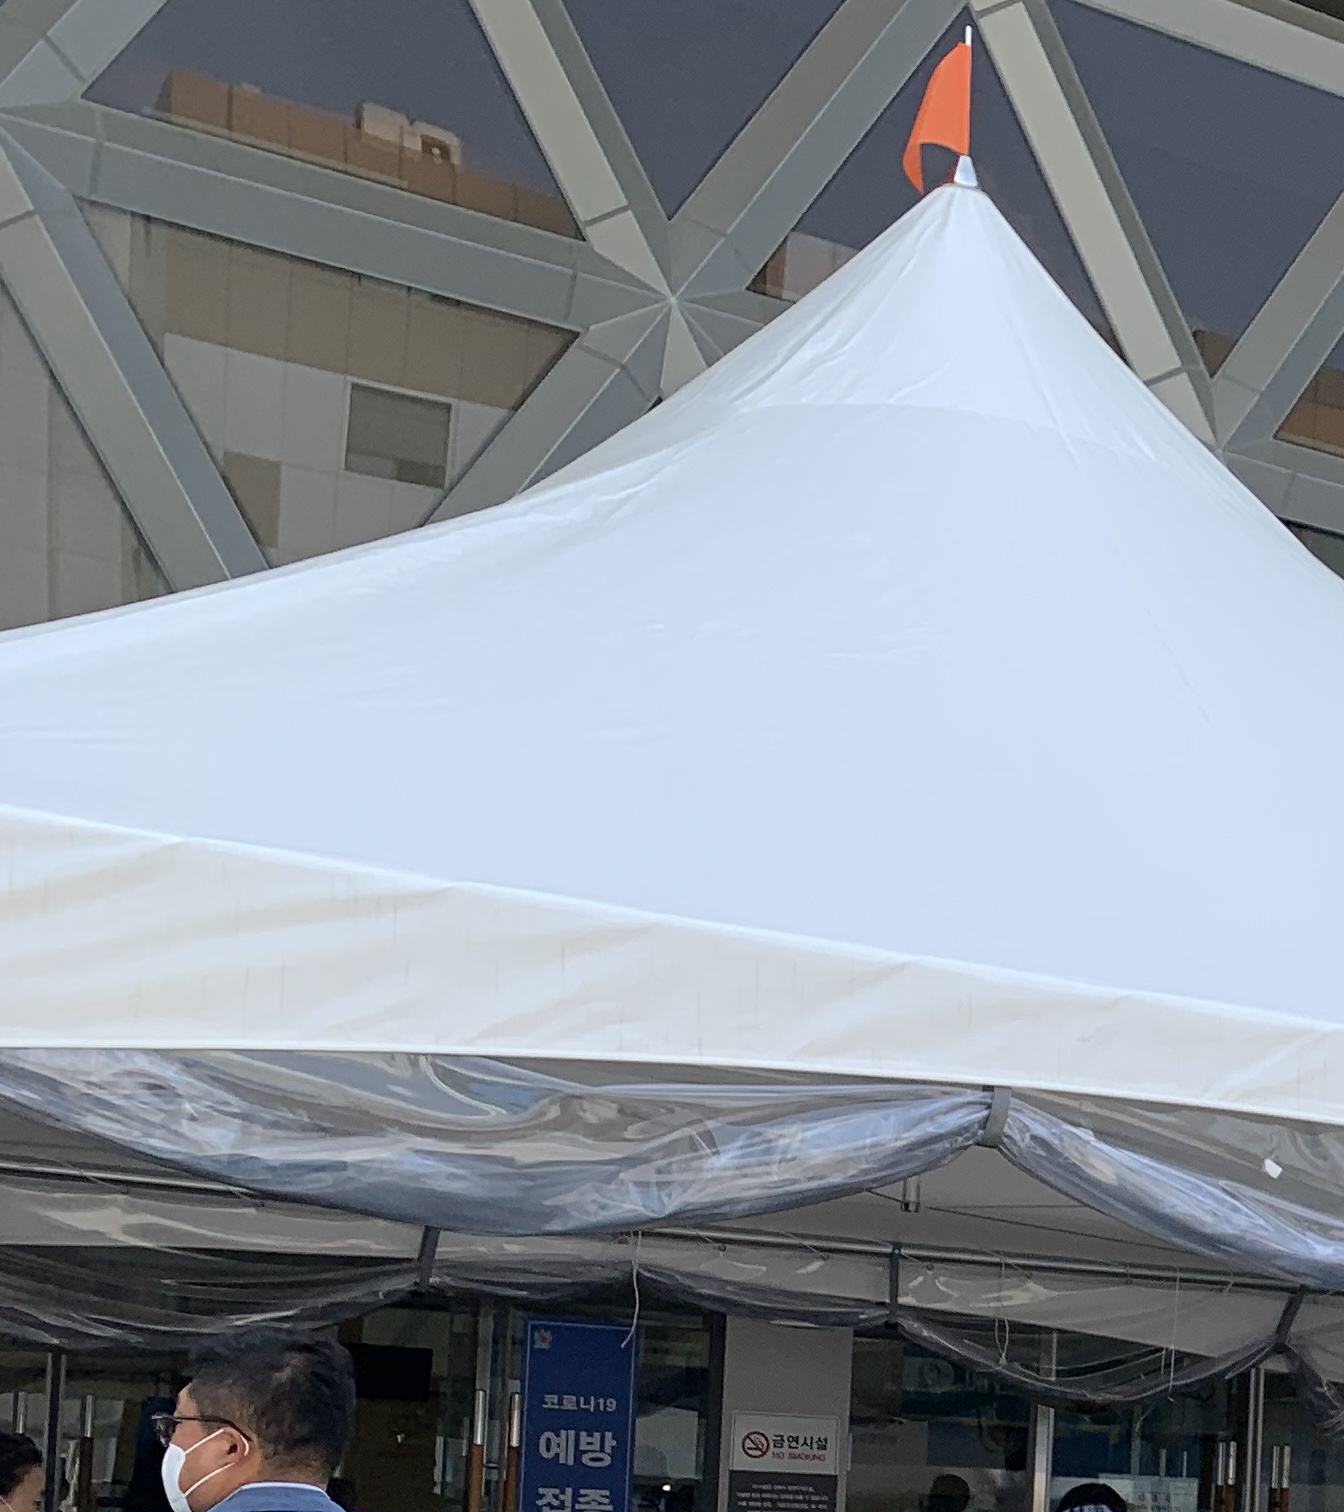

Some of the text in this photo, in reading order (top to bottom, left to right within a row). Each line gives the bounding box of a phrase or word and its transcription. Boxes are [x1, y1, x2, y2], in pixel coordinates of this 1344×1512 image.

[542, 1394, 617, 1413] 코로나19
[539, 1429, 617, 1468] 예방
[772, 1434, 829, 1451] 금연시설
